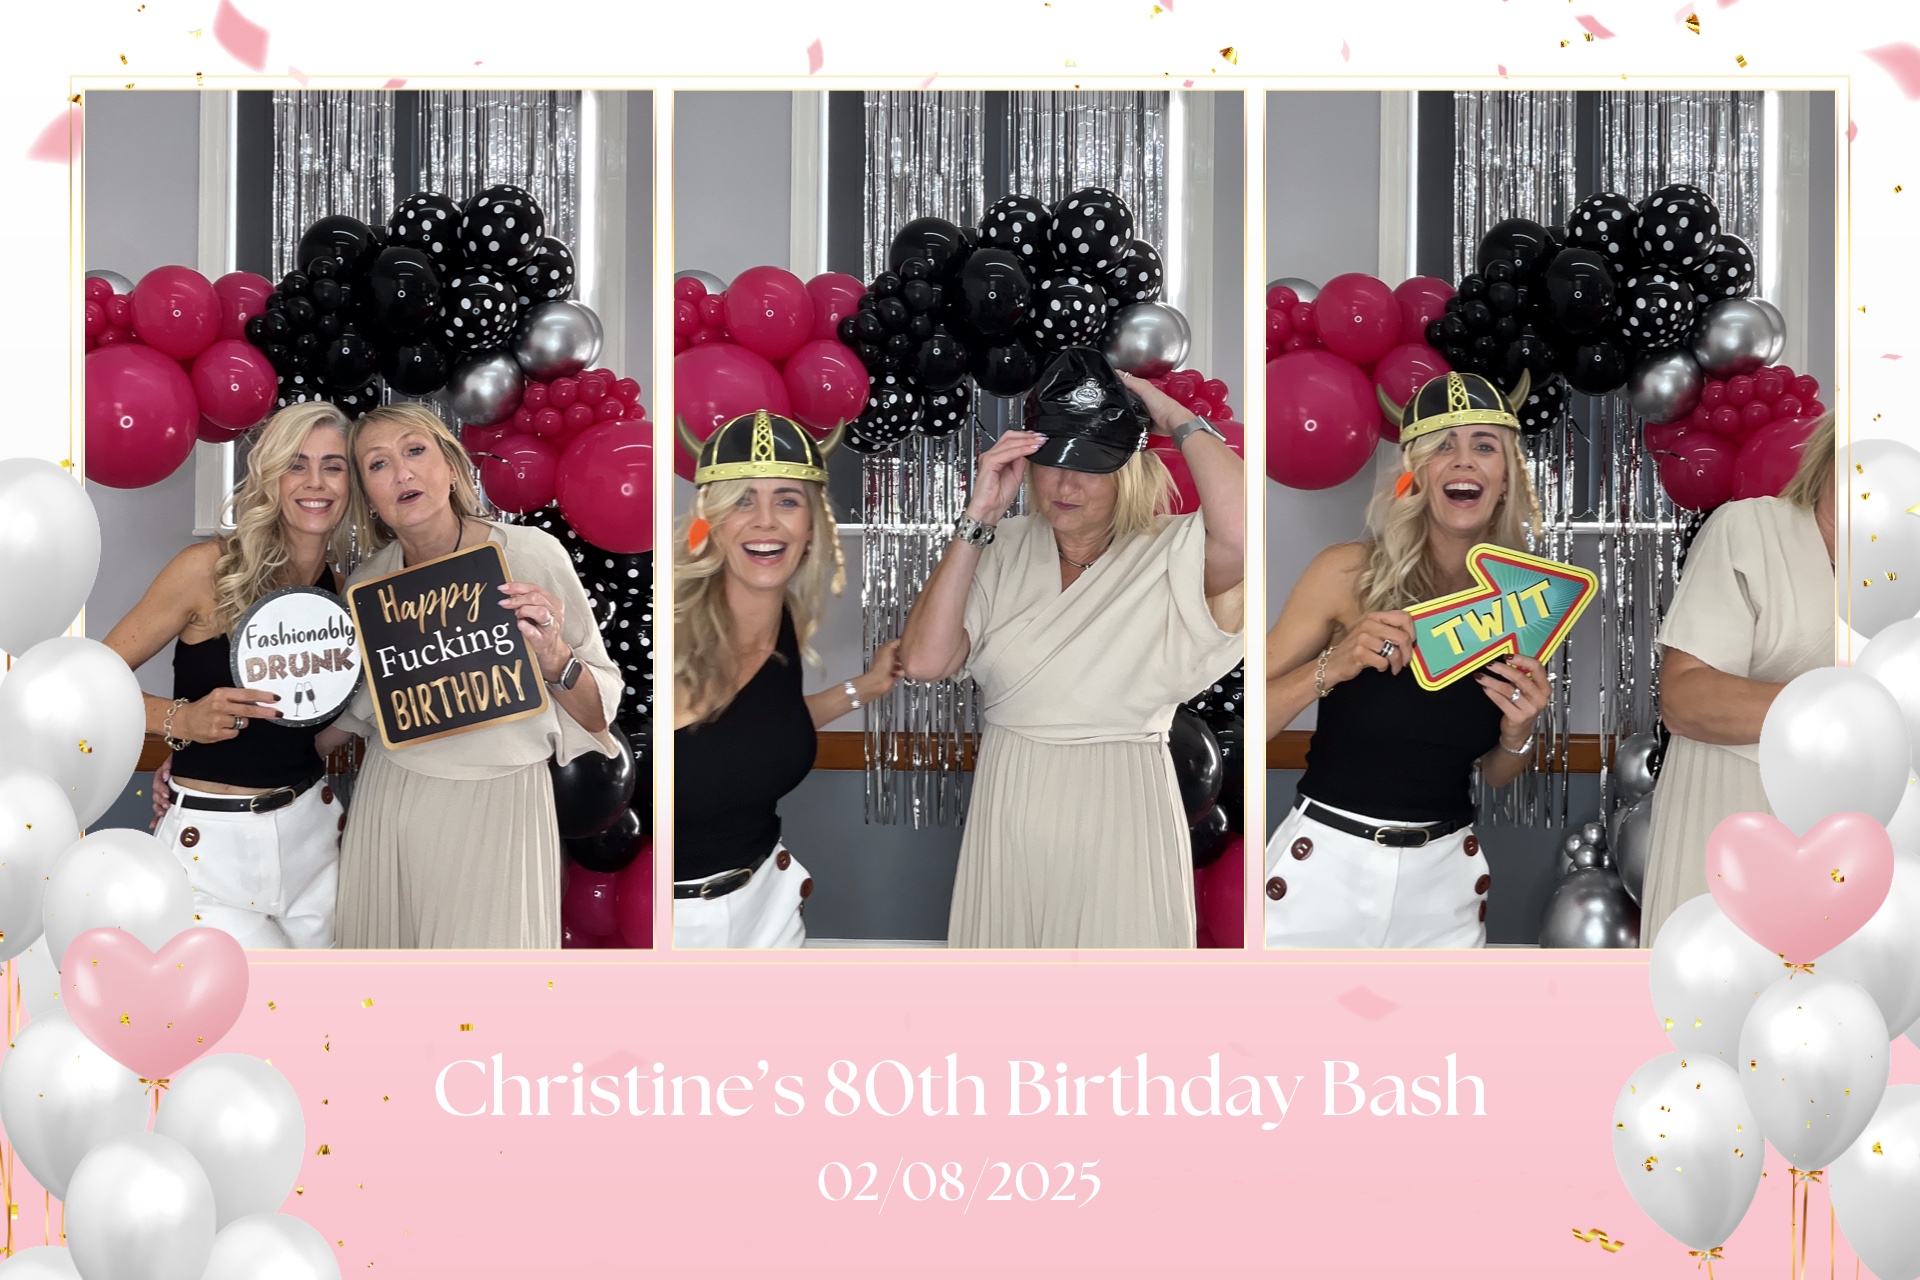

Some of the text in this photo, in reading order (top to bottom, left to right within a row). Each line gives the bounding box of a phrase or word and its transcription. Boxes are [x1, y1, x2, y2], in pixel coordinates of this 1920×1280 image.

[246, 615, 356, 649] Fashionably
[378, 582, 487, 633] Happy
[1431, 578, 1551, 655] TWIT
[246, 647, 355, 682] DRUNK
[377, 622, 515, 678] Fucking
[391, 660, 526, 730] BIRTHDAY
